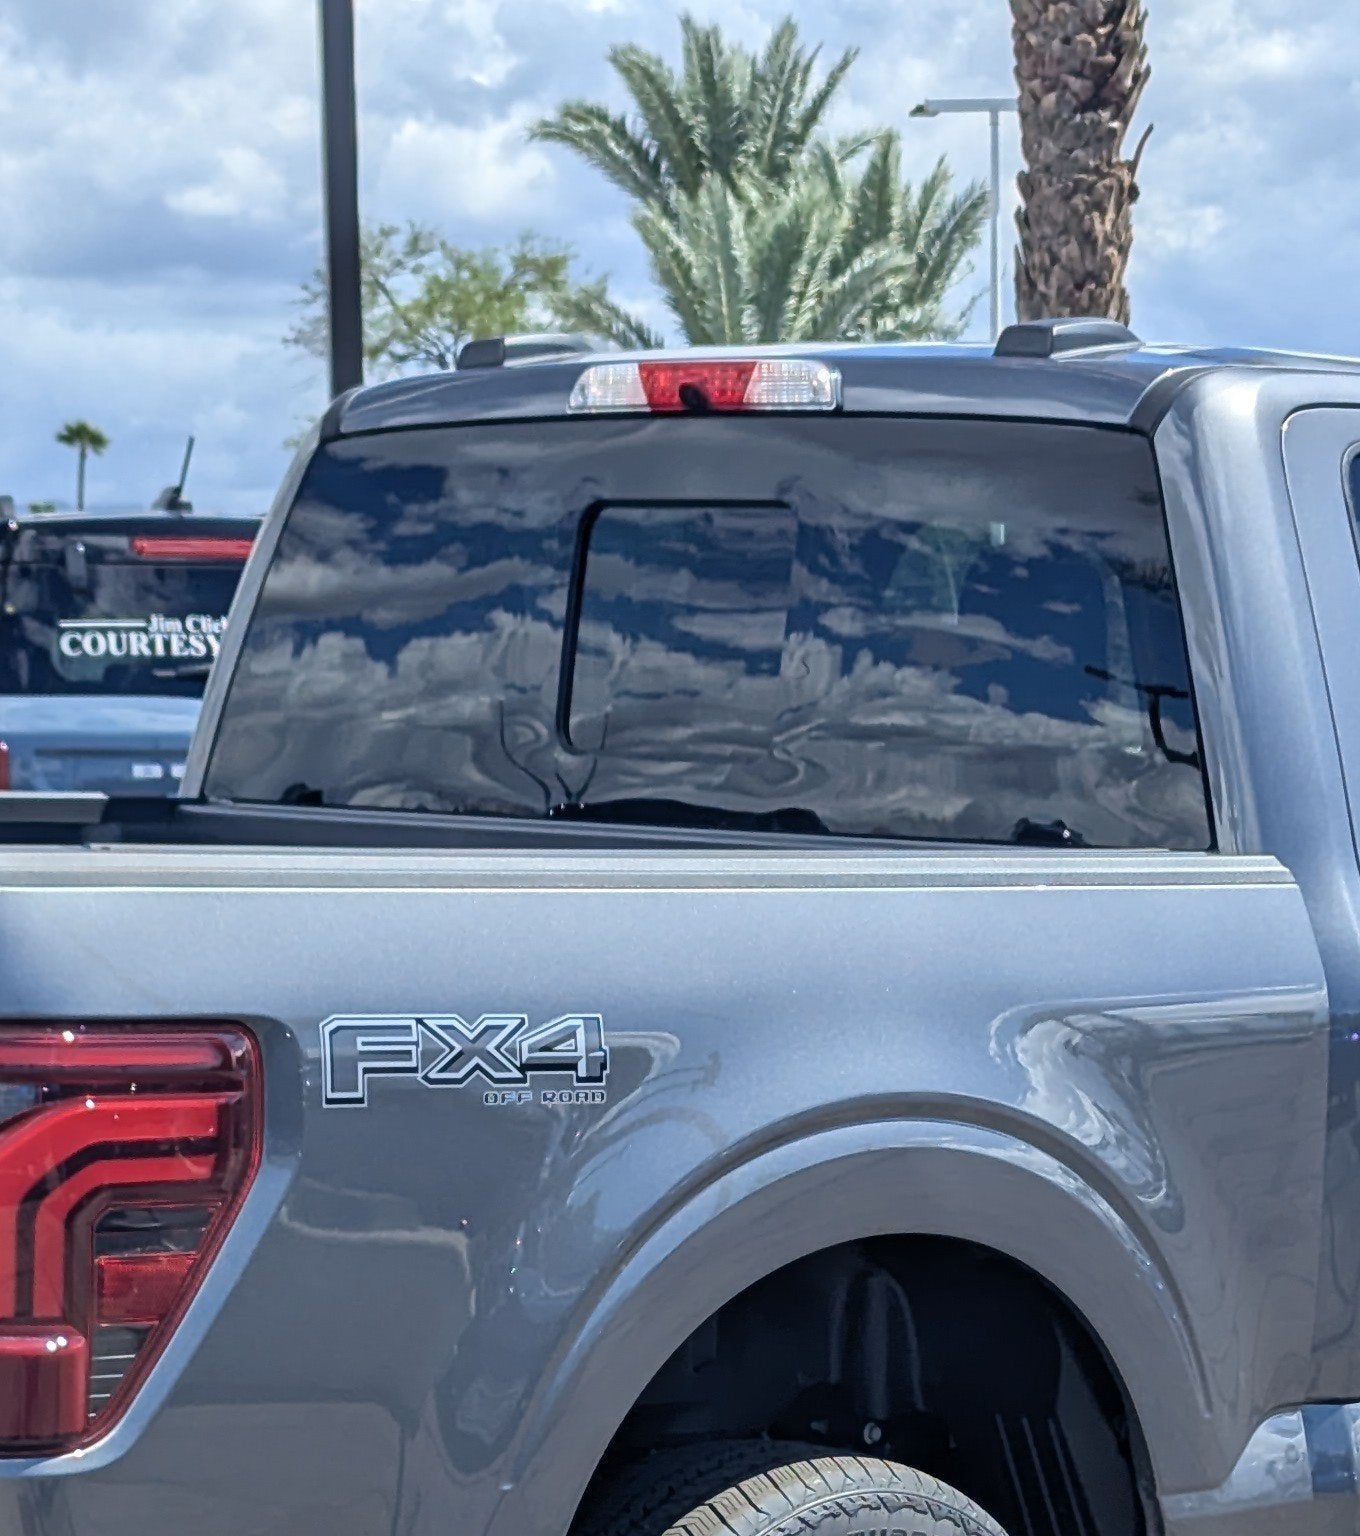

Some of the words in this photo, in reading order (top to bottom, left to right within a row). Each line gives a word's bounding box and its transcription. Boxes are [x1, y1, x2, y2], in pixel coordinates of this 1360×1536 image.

[148, 613, 183, 633] Jim
[59, 630, 222, 657] COURTESY
[319, 1013, 610, 1108] FX4
[484, 1090, 533, 1105] OFF
[541, 1089, 607, 1105] ROAD
